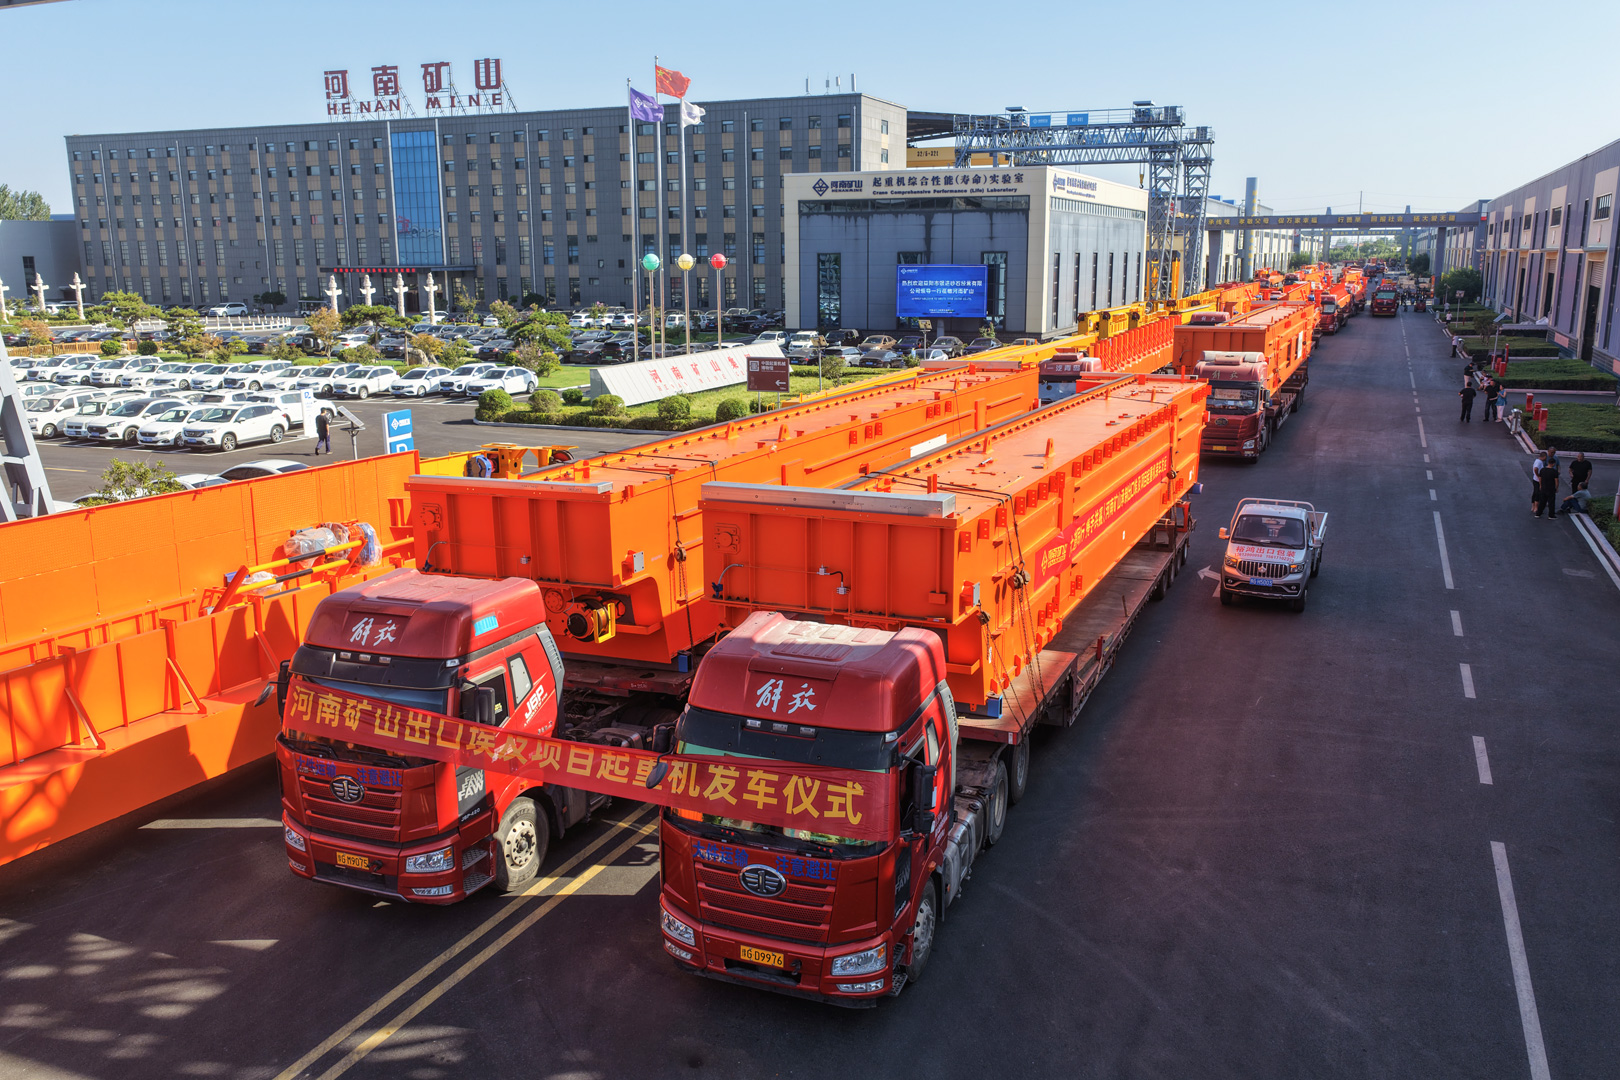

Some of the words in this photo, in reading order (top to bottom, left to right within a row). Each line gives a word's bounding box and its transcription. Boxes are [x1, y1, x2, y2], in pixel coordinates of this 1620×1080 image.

[324, 58, 501, 99] 河南矿山
[327, 98, 400, 115] HENAN
[426, 93, 502, 109] MINE
[831, 180, 862, 188] 河南矿山
[1212, 370, 1238, 379] 解放
[1236, 546, 1296, 558] 裕鸿出口包装
[350, 617, 397, 646] 解放
[755, 678, 817, 714] 解放
[290, 686, 864, 825] 河南矿山出口埃及项目起重机发车仪式
[296, 756, 337, 778] 大件运输
[356, 767, 403, 787] 注意避让
[458, 780, 484, 801] FAW
[692, 840, 749, 867] 大件运输
[775, 856, 836, 881] 注意避让
